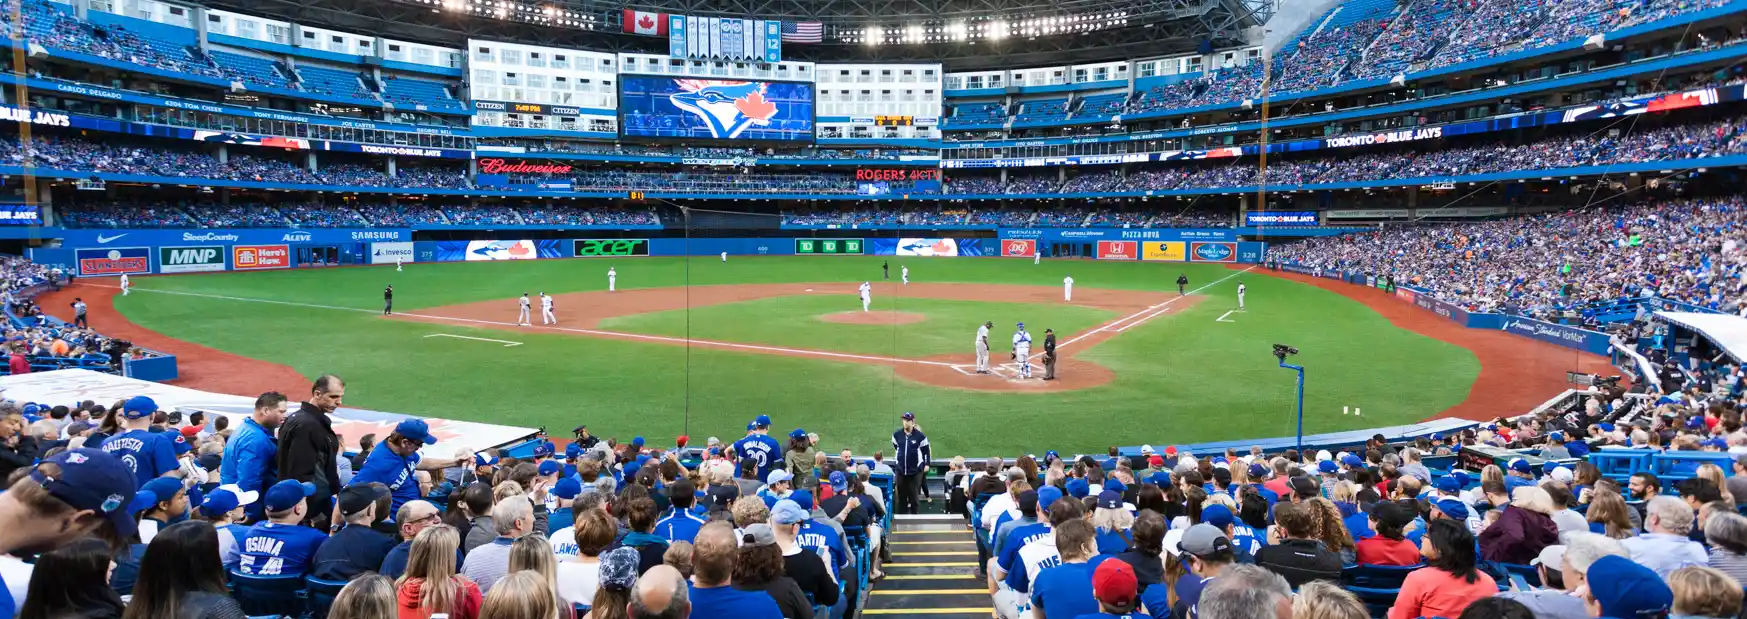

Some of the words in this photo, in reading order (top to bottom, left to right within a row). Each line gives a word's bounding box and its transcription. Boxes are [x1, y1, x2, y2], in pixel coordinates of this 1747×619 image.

[57, 83, 86, 95] CARLOS
[88, 89, 122, 100] DELGADO
[183, 102, 200, 110] TOM
[201, 104, 223, 113] CHEEK
[475, 101, 505, 111] CITIZEN
[552, 107, 580, 115] CITIZEN
[33, 111, 71, 128] JAYS
[254, 111, 271, 119] TONY
[273, 113, 309, 123] FERNANDEZ
[1217, 126, 1238, 134] ALOMAR
[1326, 134, 1375, 148] TORONTO
[1386, 130, 1413, 143] BLUE
[1413, 126, 1443, 140] JAYS
[361, 144, 398, 155] TORONTO
[405, 148, 423, 156] BLUE
[424, 150, 441, 158] JAYS
[479, 158, 573, 174] Budweiser
[856, 168, 906, 181] ROGERS
[12, 211, 38, 220] JAYS
[351, 231, 399, 240] SAMSUNG
[1122, 231, 1141, 239] PIZZA
[1143, 231, 1160, 239] NOVA
[258, 247, 286, 257] Here's
[385, 248, 412, 256] Invesco
[580, 239, 643, 256] acer
[801, 242, 813, 251] TD
[823, 242, 836, 251] TD
[847, 242, 859, 251] TD
[1009, 243, 1025, 252] DQ
[169, 249, 217, 264] MNP
[1533, 323, 1561, 338] Standard
[102, 437, 145, 453] BAUTISTA
[245, 536, 285, 557] OSUNA
[553, 543, 580, 557] LAWR
